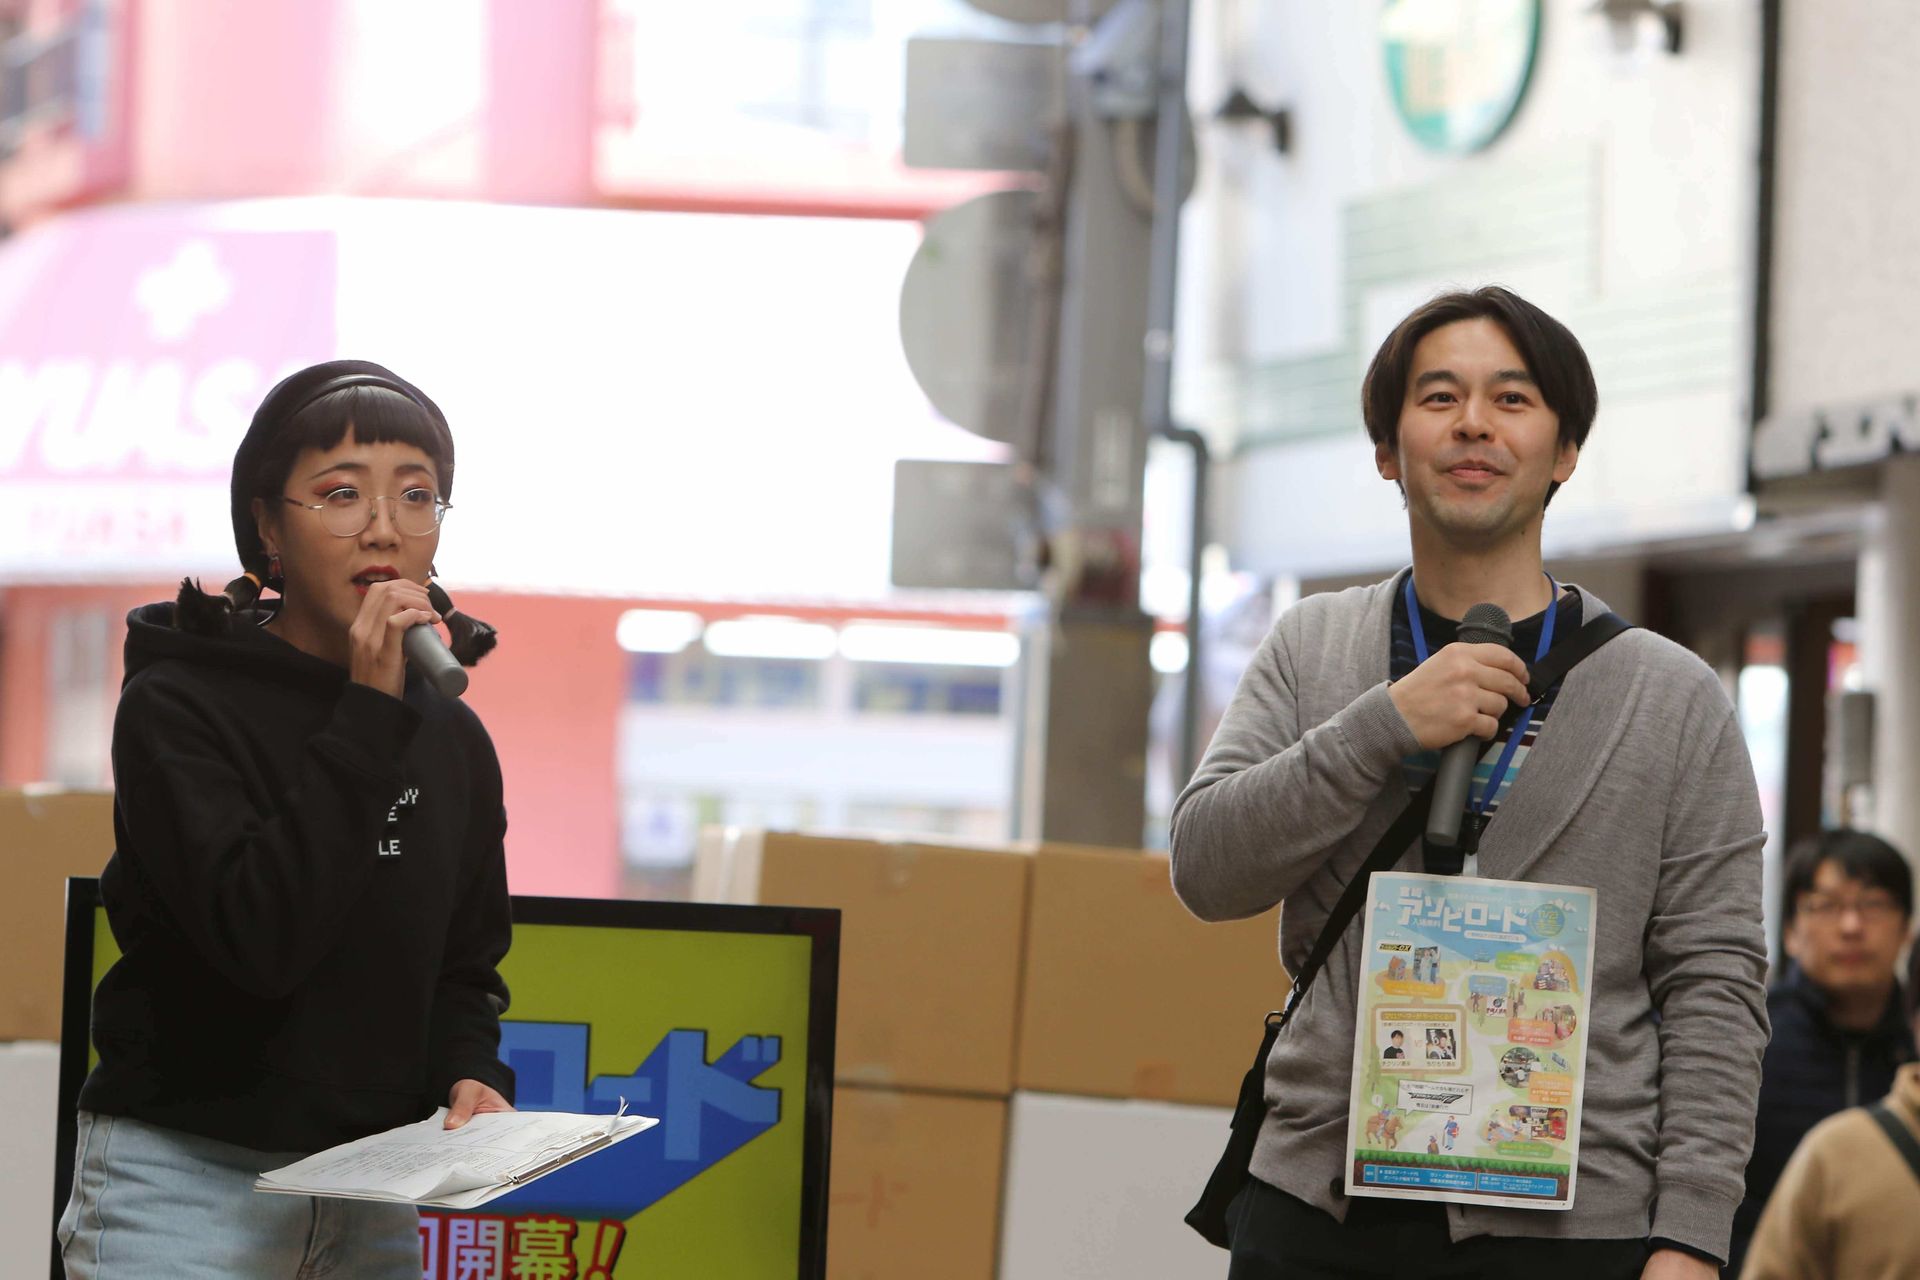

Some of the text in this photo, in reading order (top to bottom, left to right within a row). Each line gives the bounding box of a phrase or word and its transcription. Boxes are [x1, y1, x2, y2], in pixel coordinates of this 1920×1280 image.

[378, 840, 401, 856] LE
[499, 1020, 782, 1161] ロード
